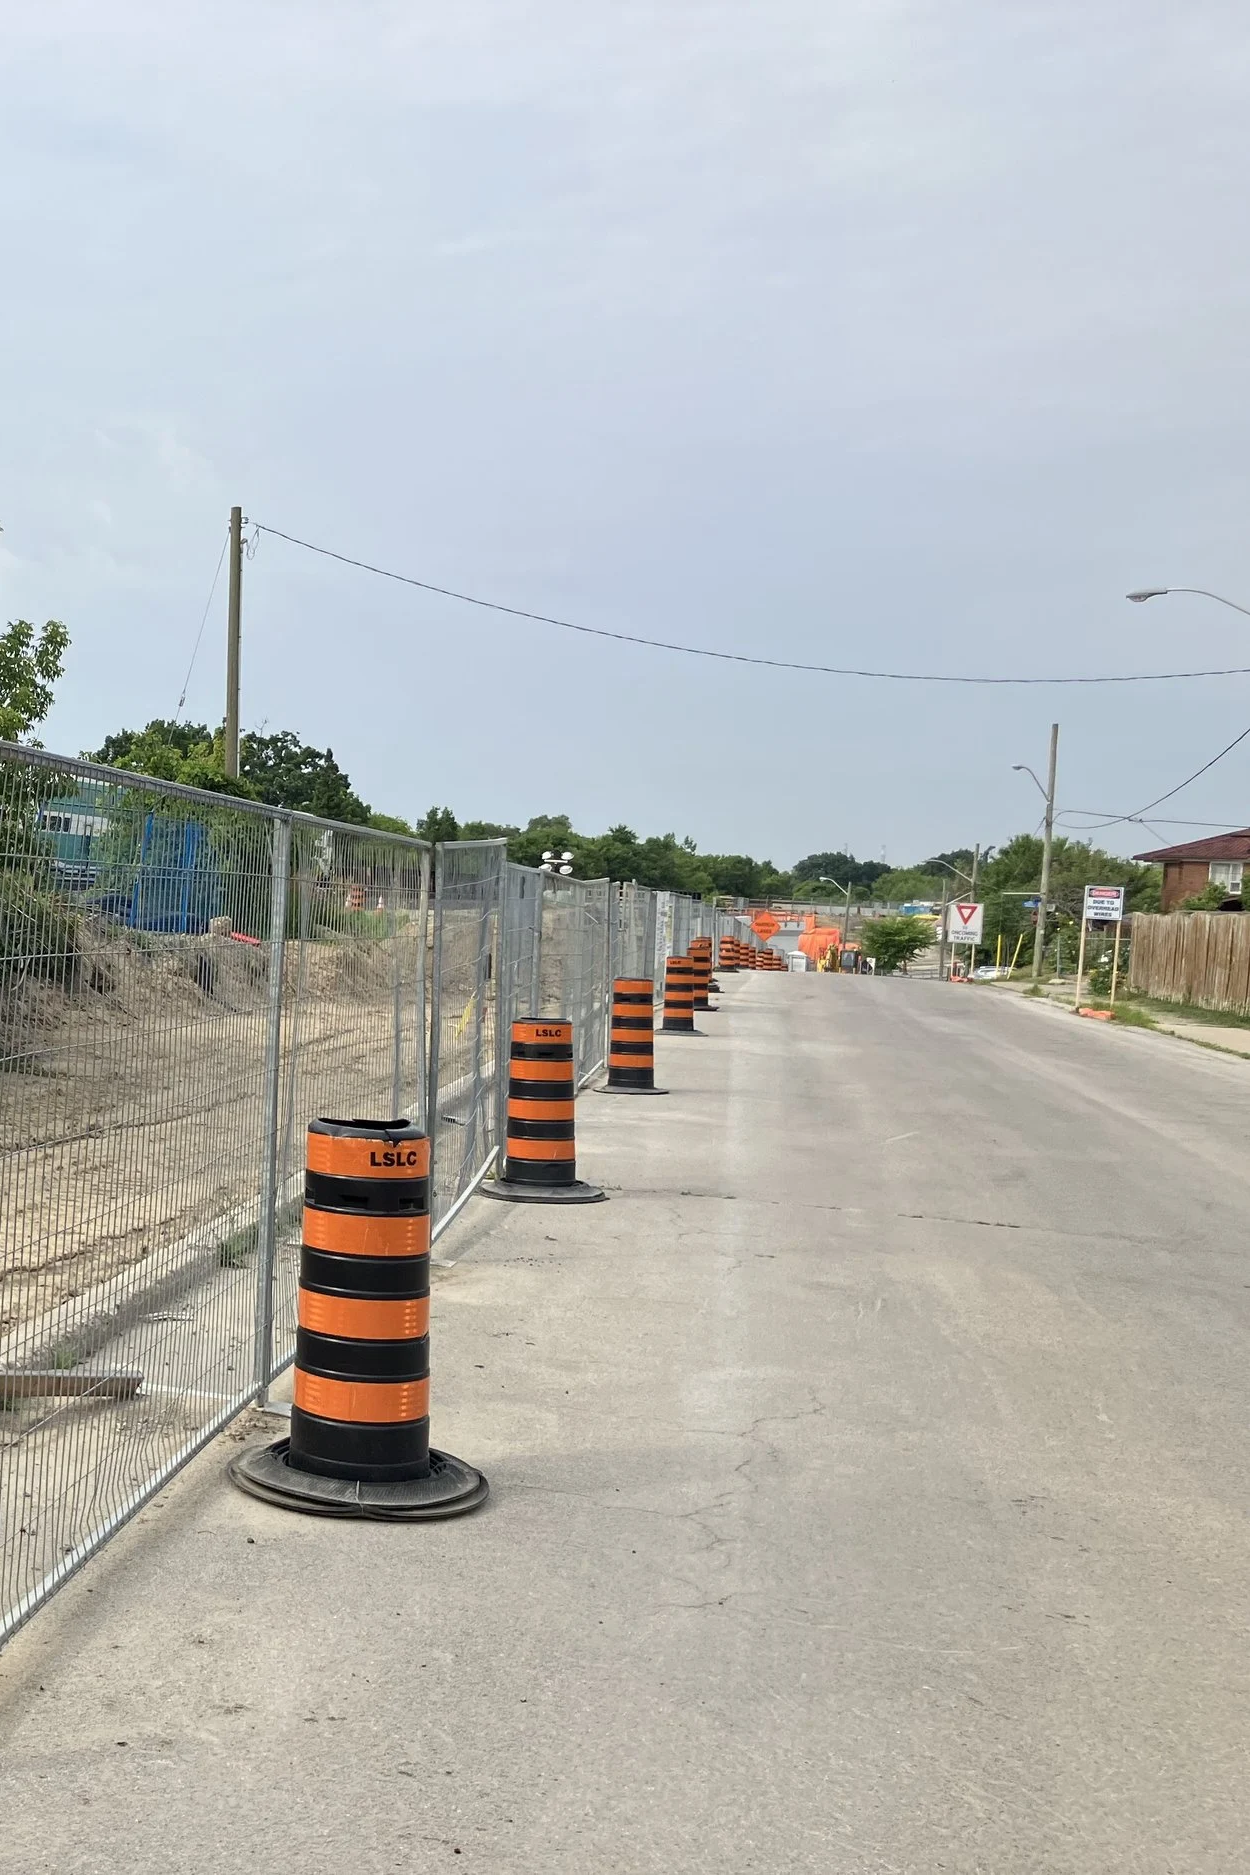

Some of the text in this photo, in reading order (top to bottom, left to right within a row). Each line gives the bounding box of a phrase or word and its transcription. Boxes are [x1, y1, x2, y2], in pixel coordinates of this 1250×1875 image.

[951, 929, 978, 937] ONCOMING
[535, 1028, 562, 1038] LSLC
[370, 1150, 417, 1167] LSLC
